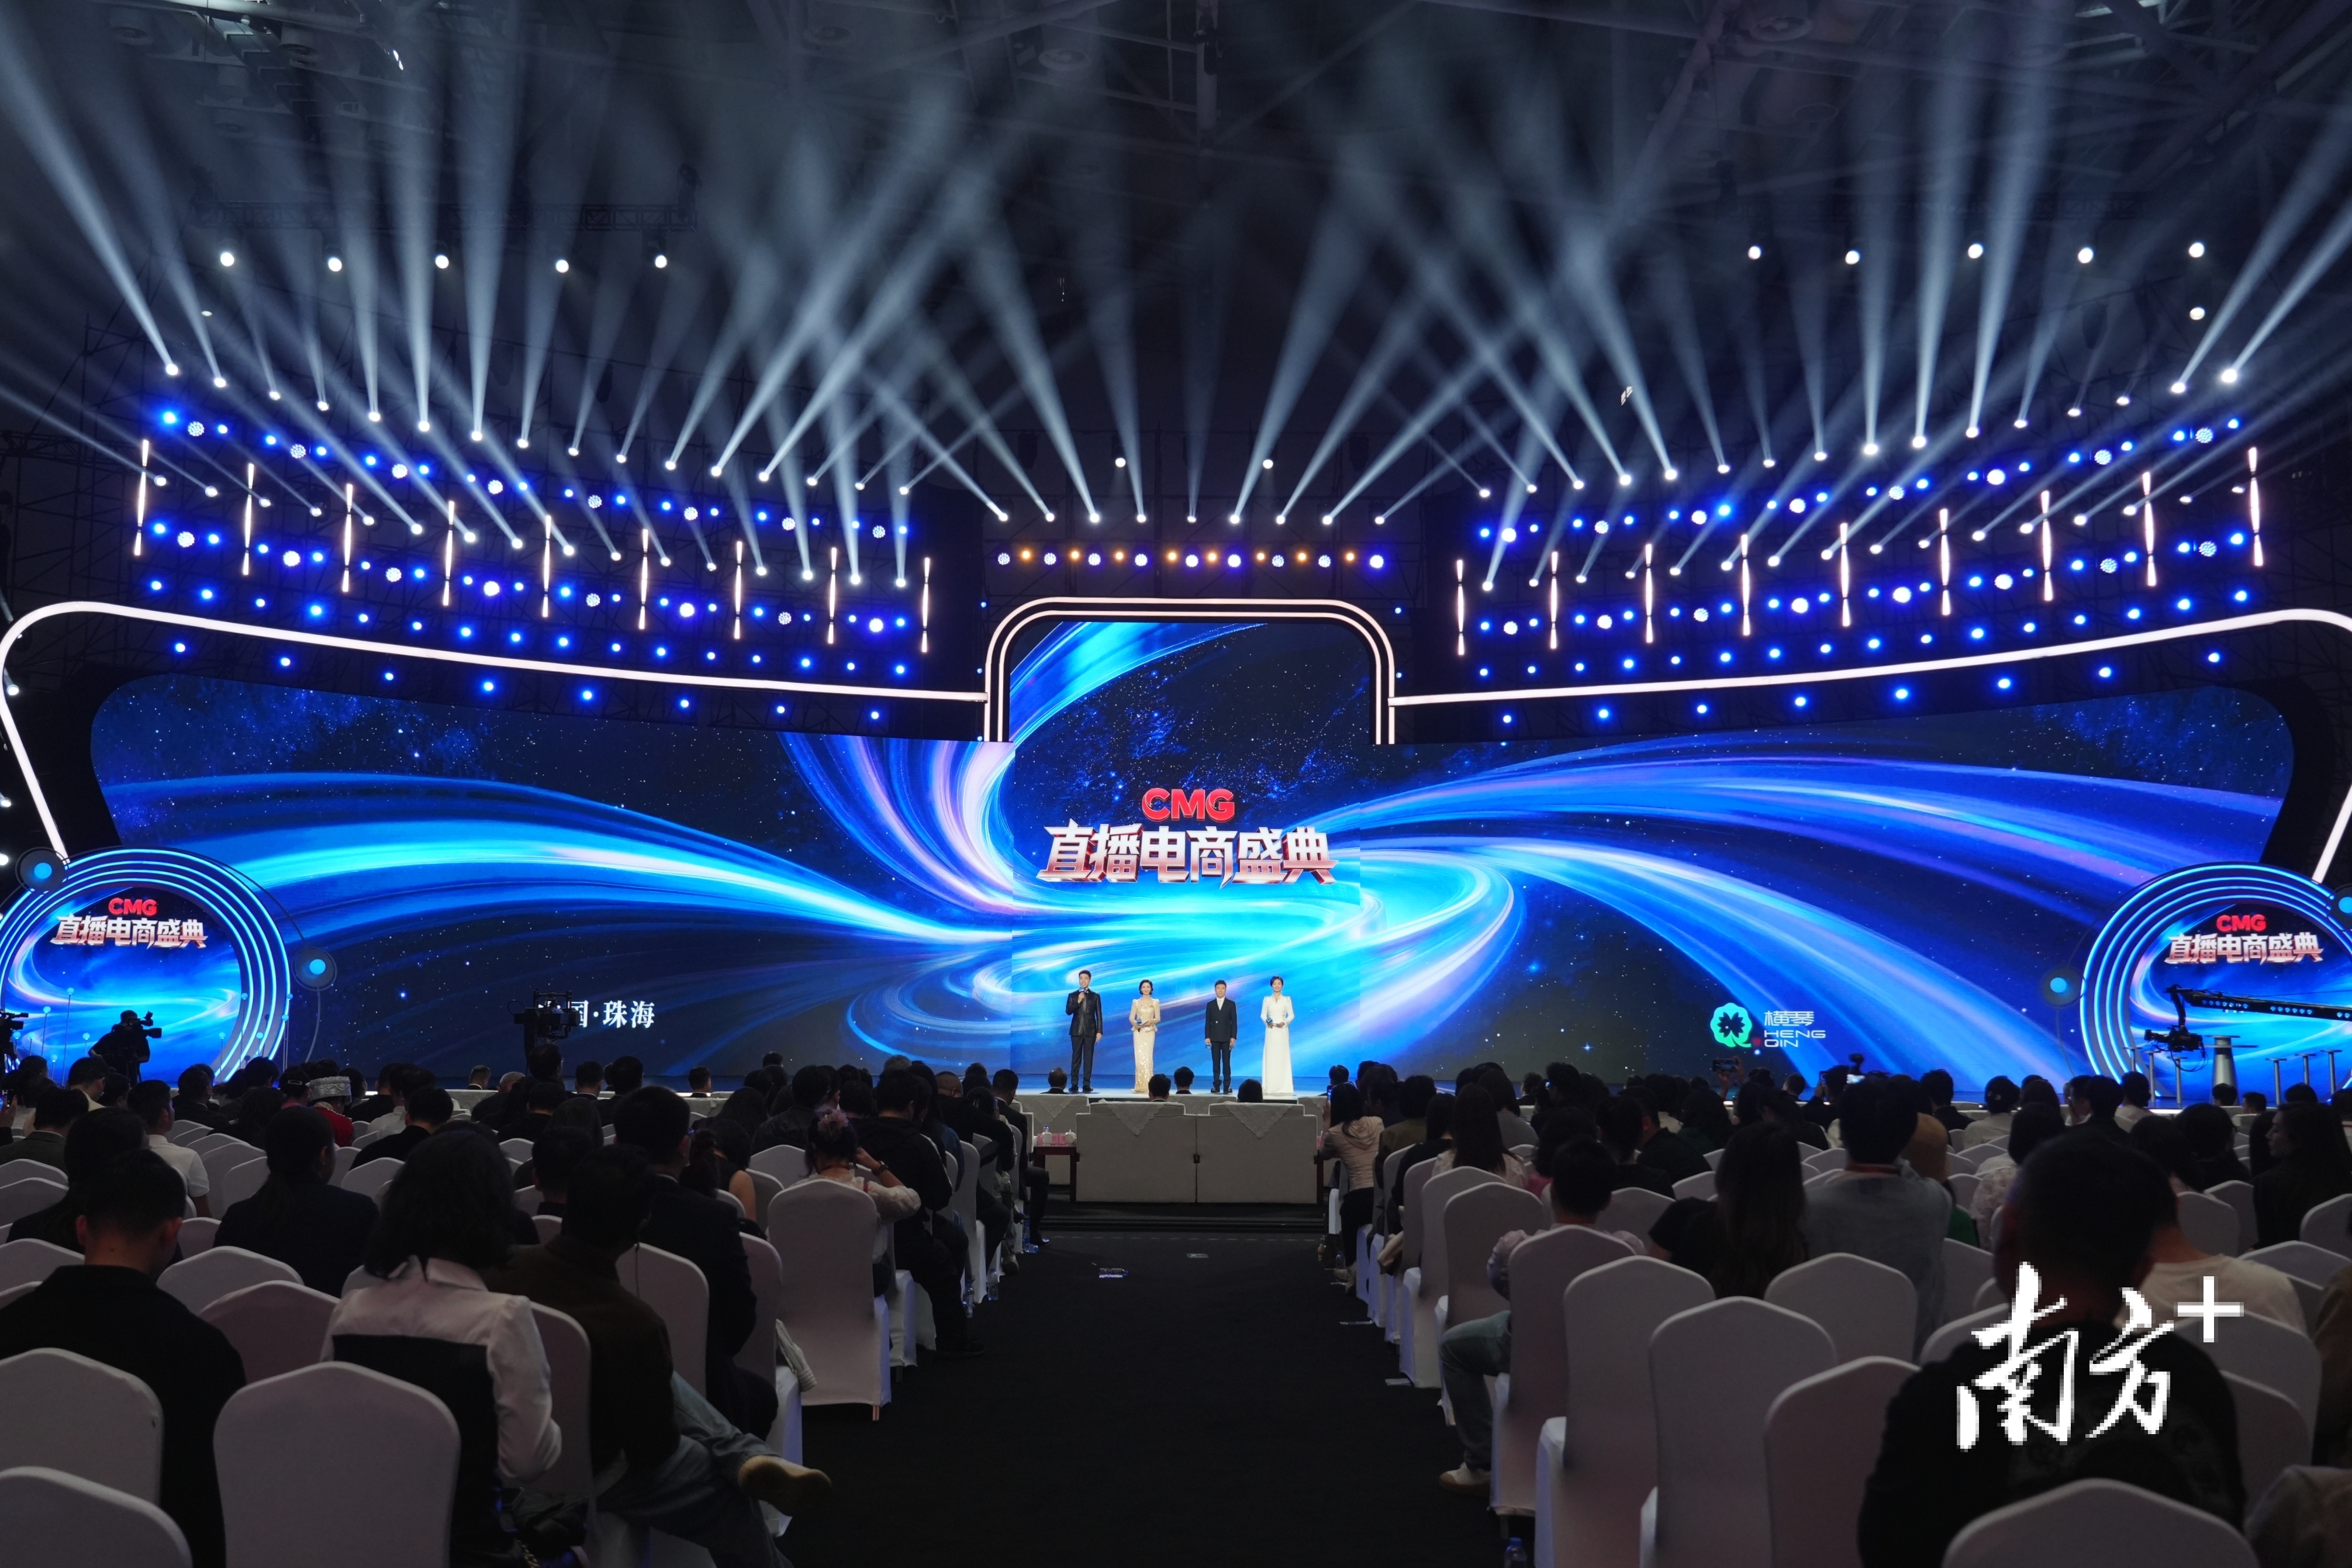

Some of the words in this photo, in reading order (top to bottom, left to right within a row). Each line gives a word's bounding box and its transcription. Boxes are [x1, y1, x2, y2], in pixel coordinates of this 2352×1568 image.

[1141, 788, 1235, 823] CMG
[1037, 819, 1339, 889] 直播电商盛典
[108, 897, 158, 916] CMG
[50, 913, 208, 949] 直播电商盛典
[2216, 914, 2267, 932] CMG
[2164, 932, 2324, 965] 直播电商盛典
[1764, 1010, 1814, 1027] 横琴
[1764, 1030, 1826, 1038] HENG
[1764, 1039, 1798, 1048] QIN
